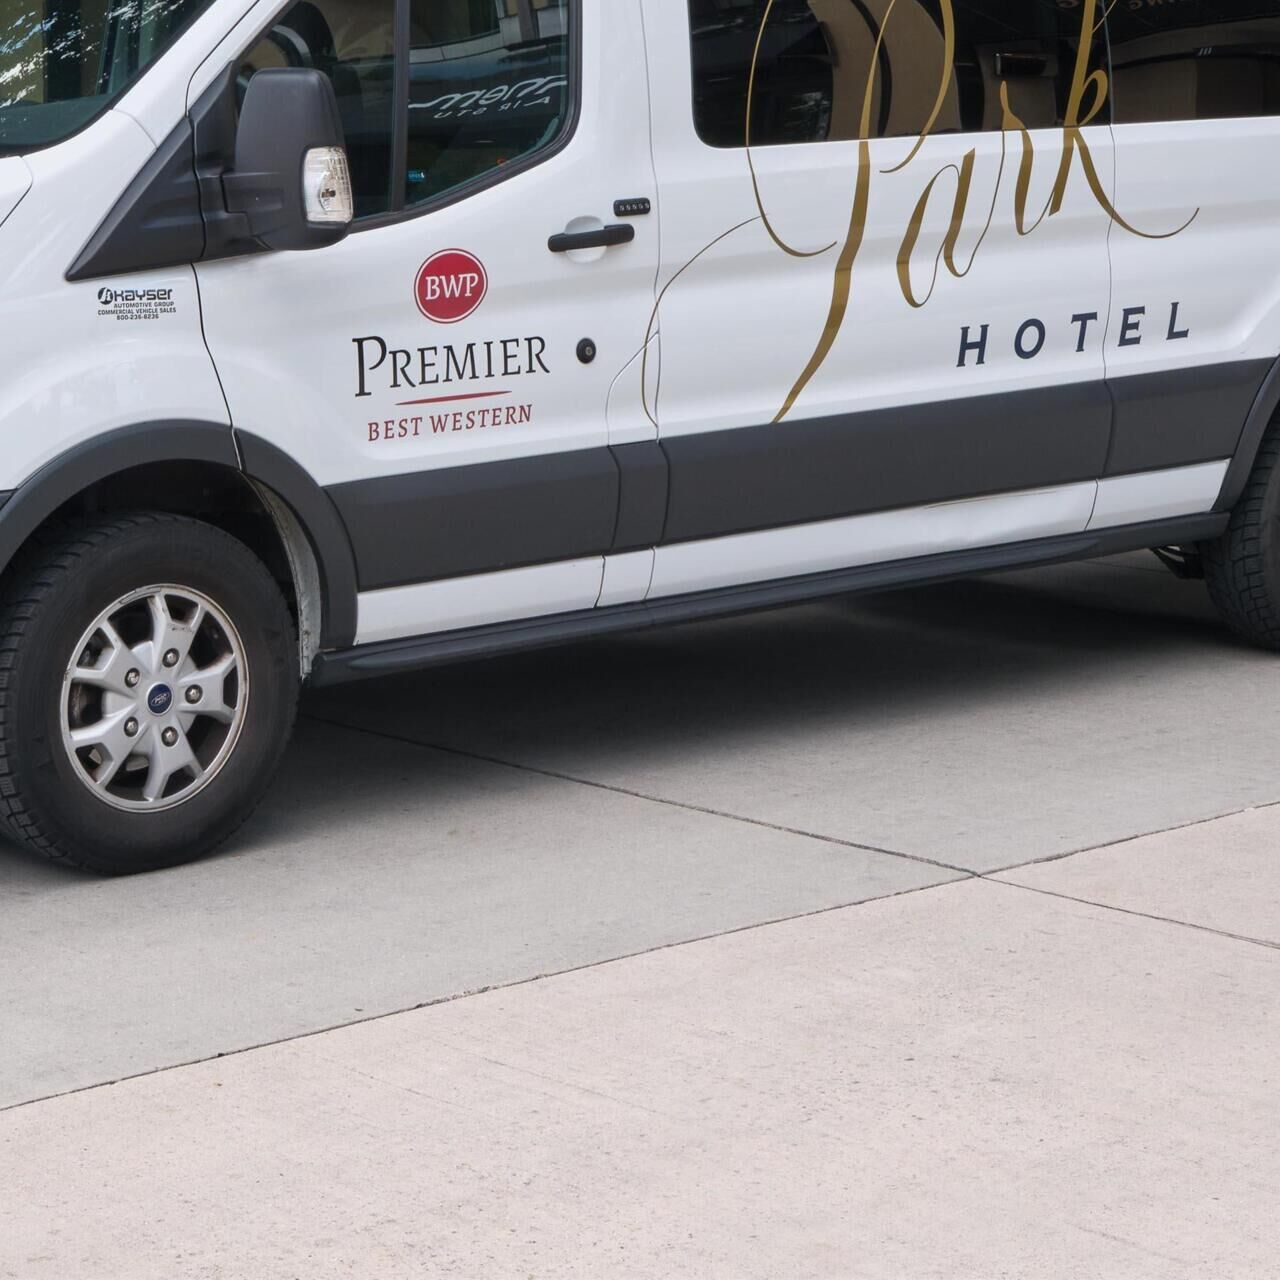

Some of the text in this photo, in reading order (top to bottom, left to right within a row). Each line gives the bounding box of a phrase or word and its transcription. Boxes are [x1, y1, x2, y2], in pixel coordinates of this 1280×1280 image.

[425, 273, 479, 301] BWP
[956, 301, 1189, 367] HOTEL
[351, 335, 550, 397] PREMIER
[367, 404, 533, 442] BEST WESTERN
